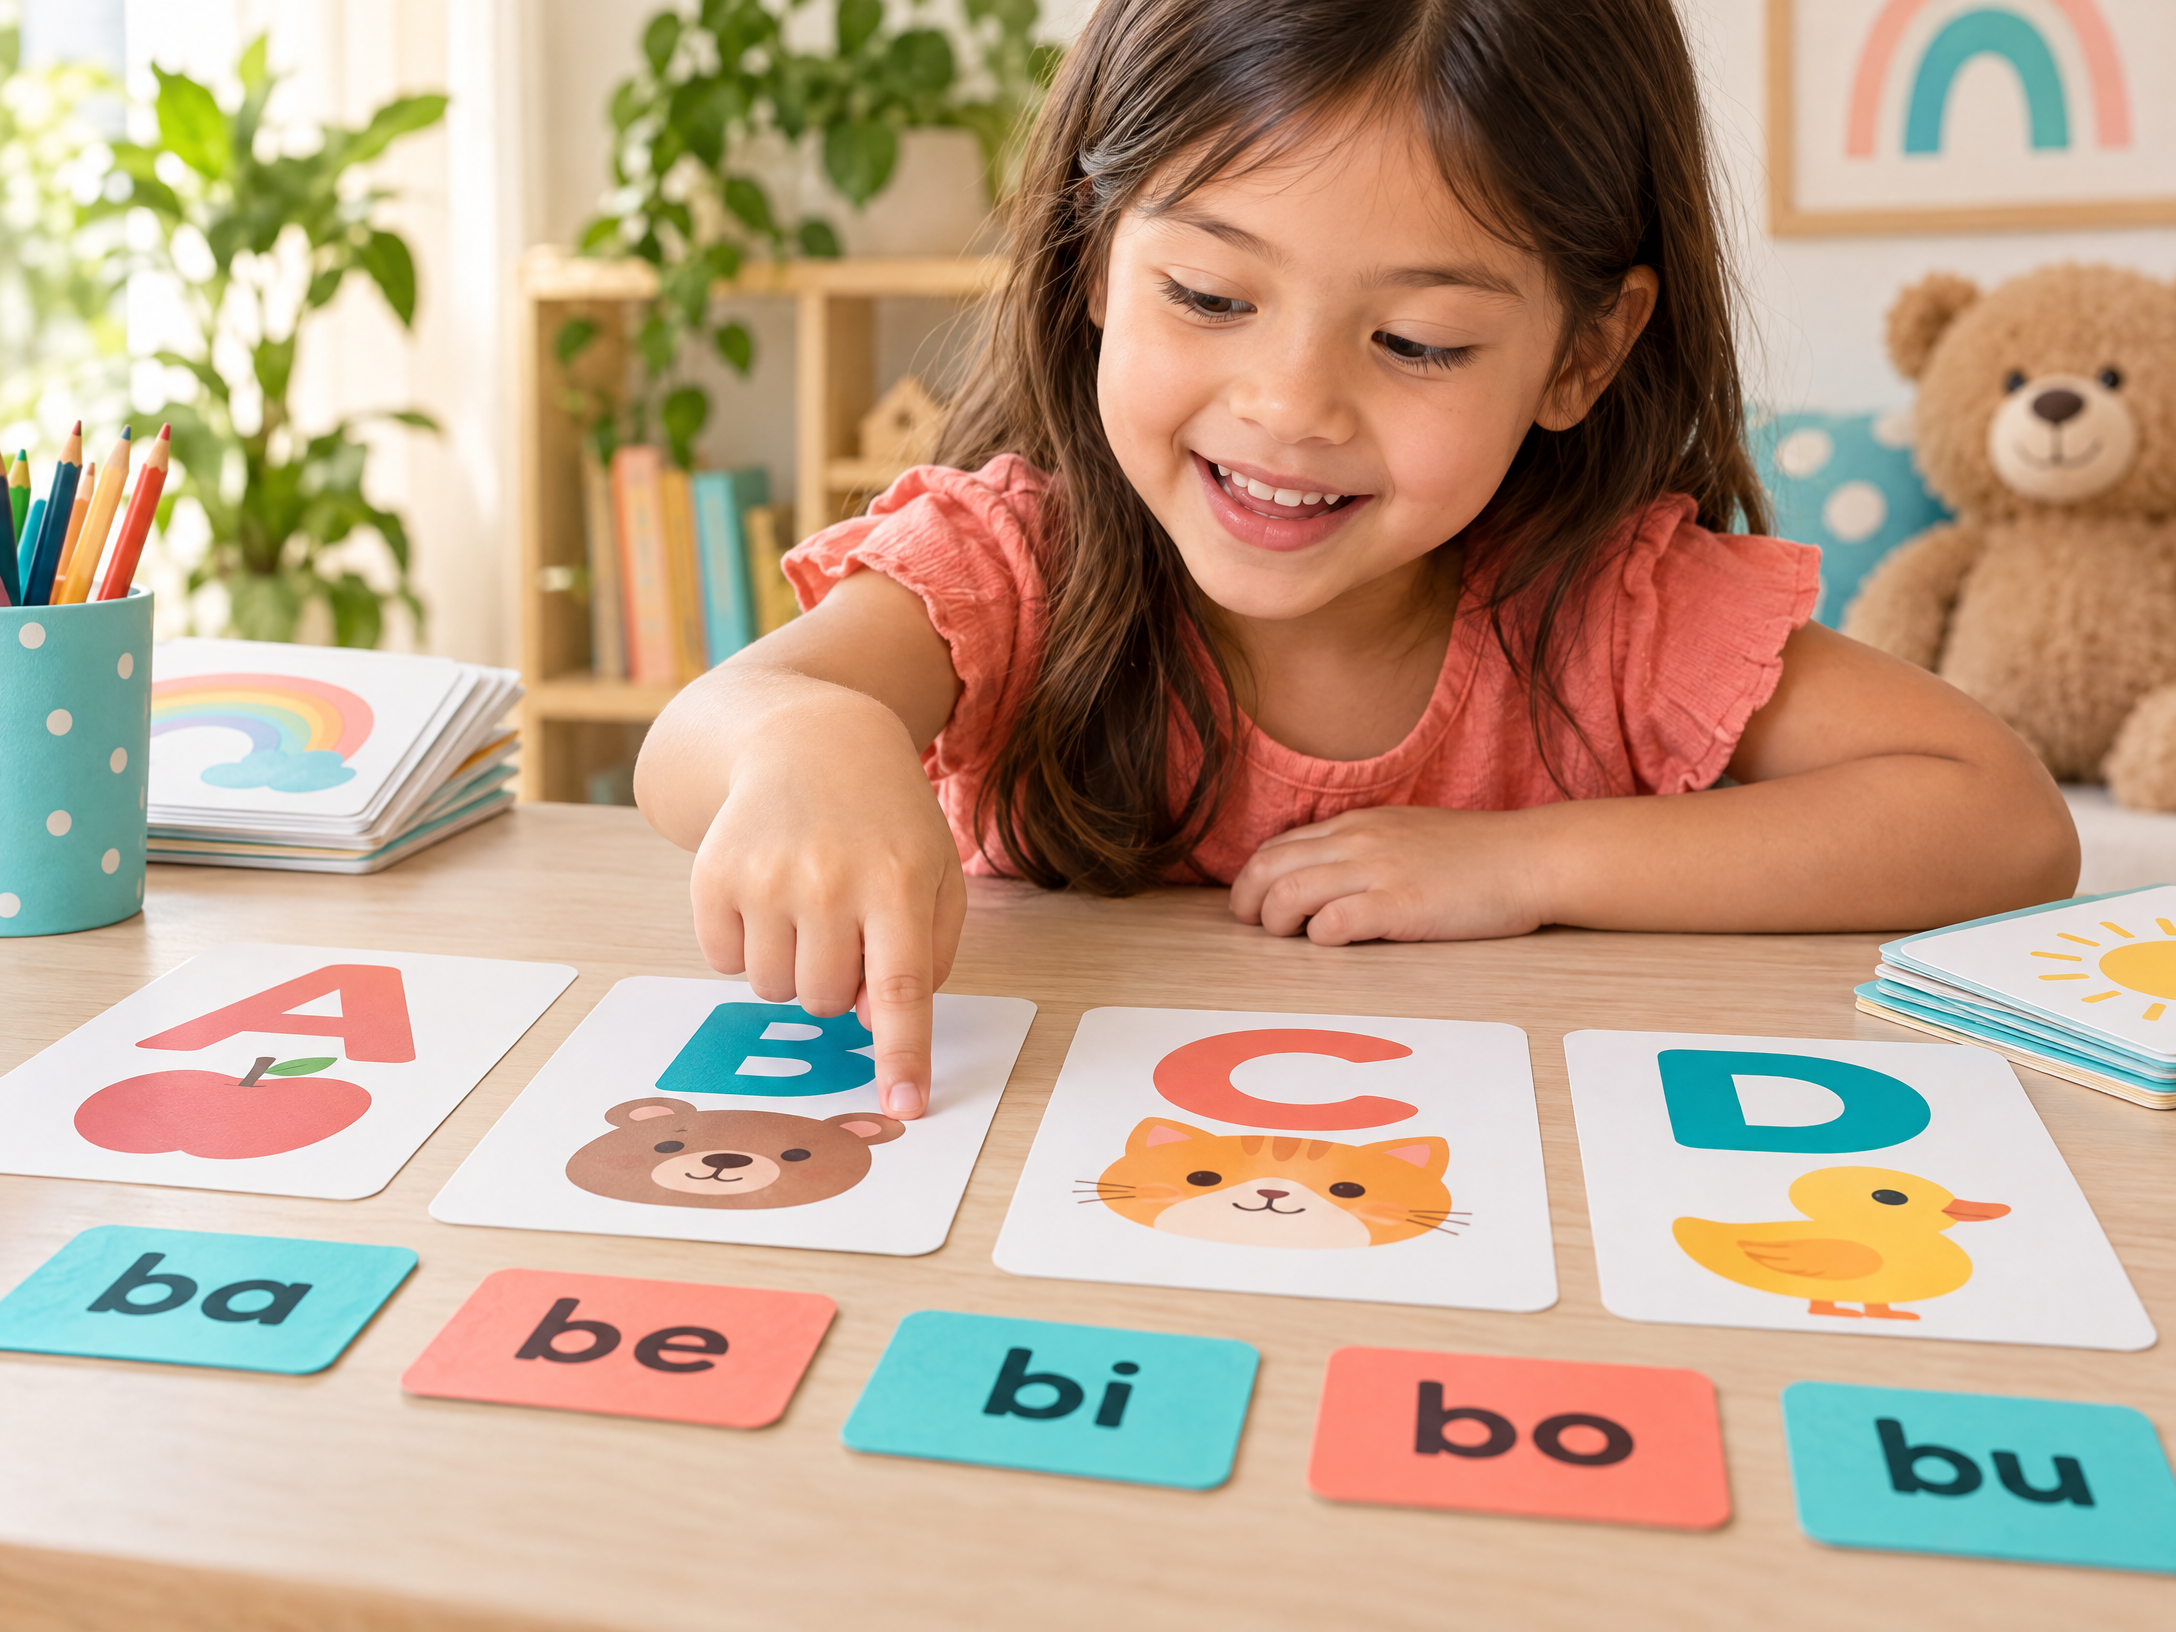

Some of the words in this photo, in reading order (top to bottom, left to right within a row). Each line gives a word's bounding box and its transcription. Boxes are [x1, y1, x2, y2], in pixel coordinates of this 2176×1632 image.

[136, 964, 415, 1063] A
[655, 1002, 876, 1097] B
[1153, 1029, 1418, 1131] C
[1657, 1049, 1931, 1154] D
[86, 1252, 313, 1325] ba
[514, 1297, 730, 1373] be
[982, 1347, 1141, 1430] bi
[1413, 1380, 1636, 1468] bo
[1874, 1417, 2097, 1509] bu
